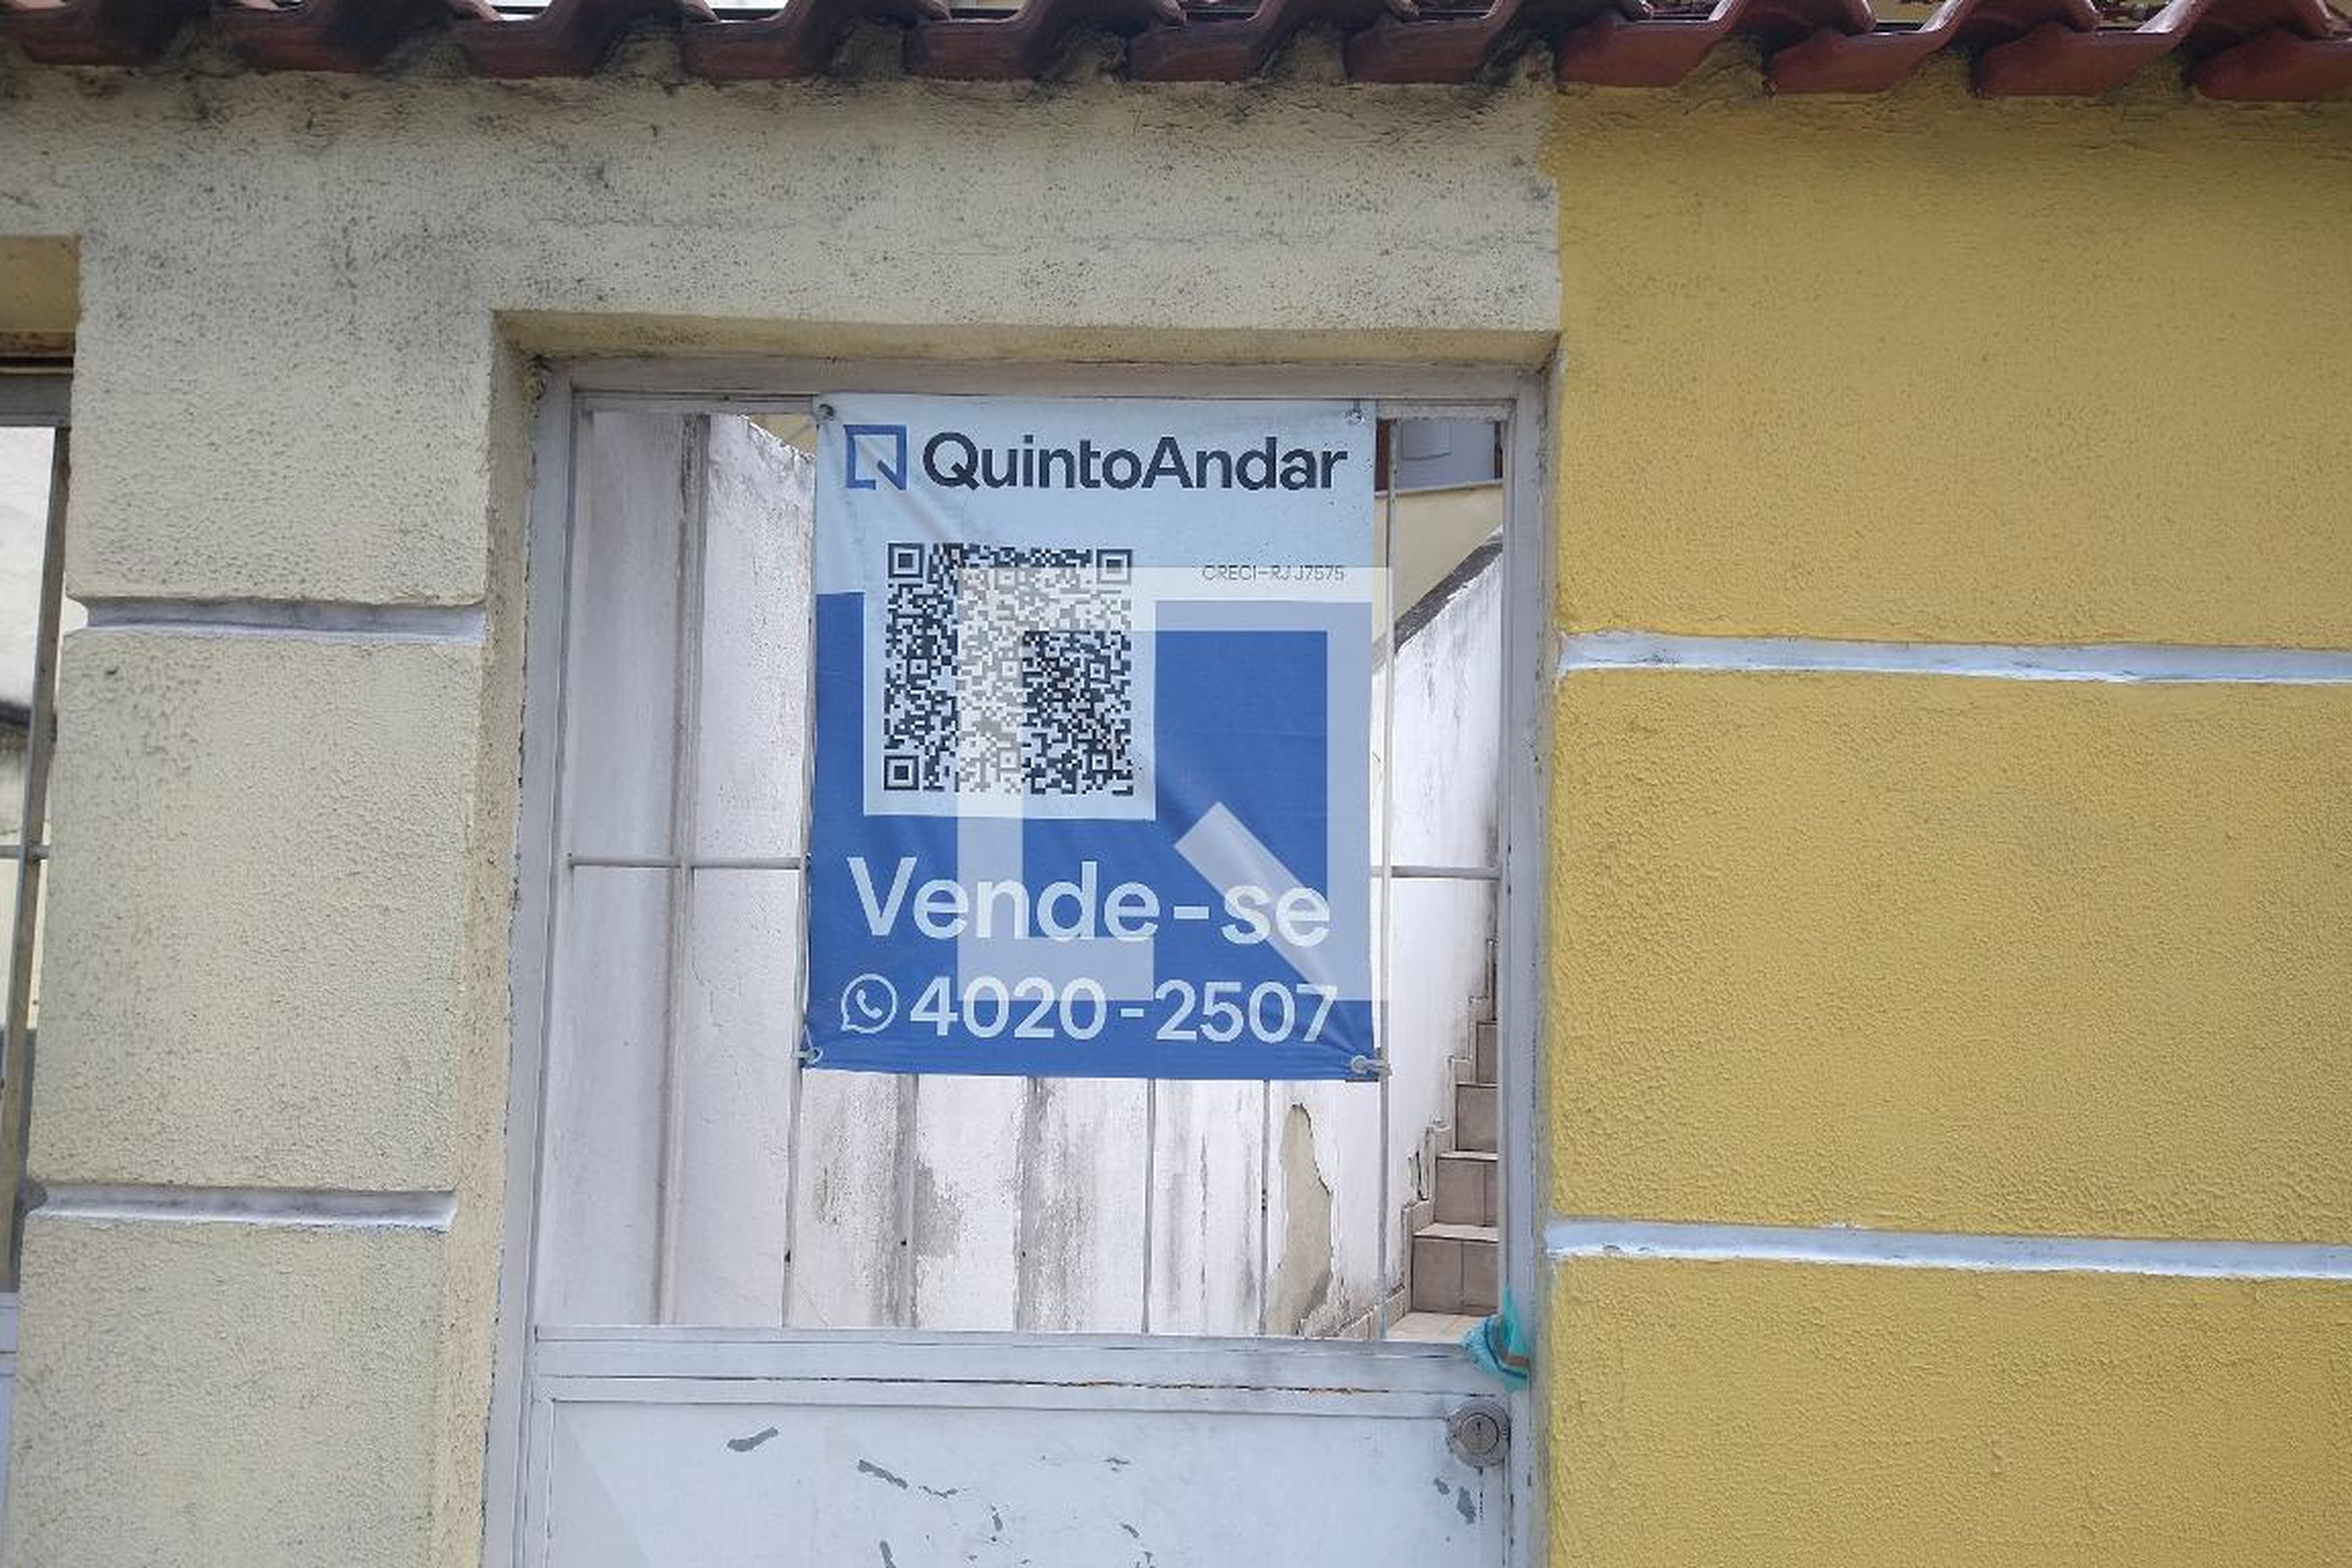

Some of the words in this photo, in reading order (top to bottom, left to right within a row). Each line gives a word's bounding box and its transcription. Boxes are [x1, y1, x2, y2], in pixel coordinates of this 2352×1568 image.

[922, 431, 1348, 491] QuintoAndar
[847, 856, 1331, 947] Vende-se
[910, 976, 1338, 1043] 4020-2507
